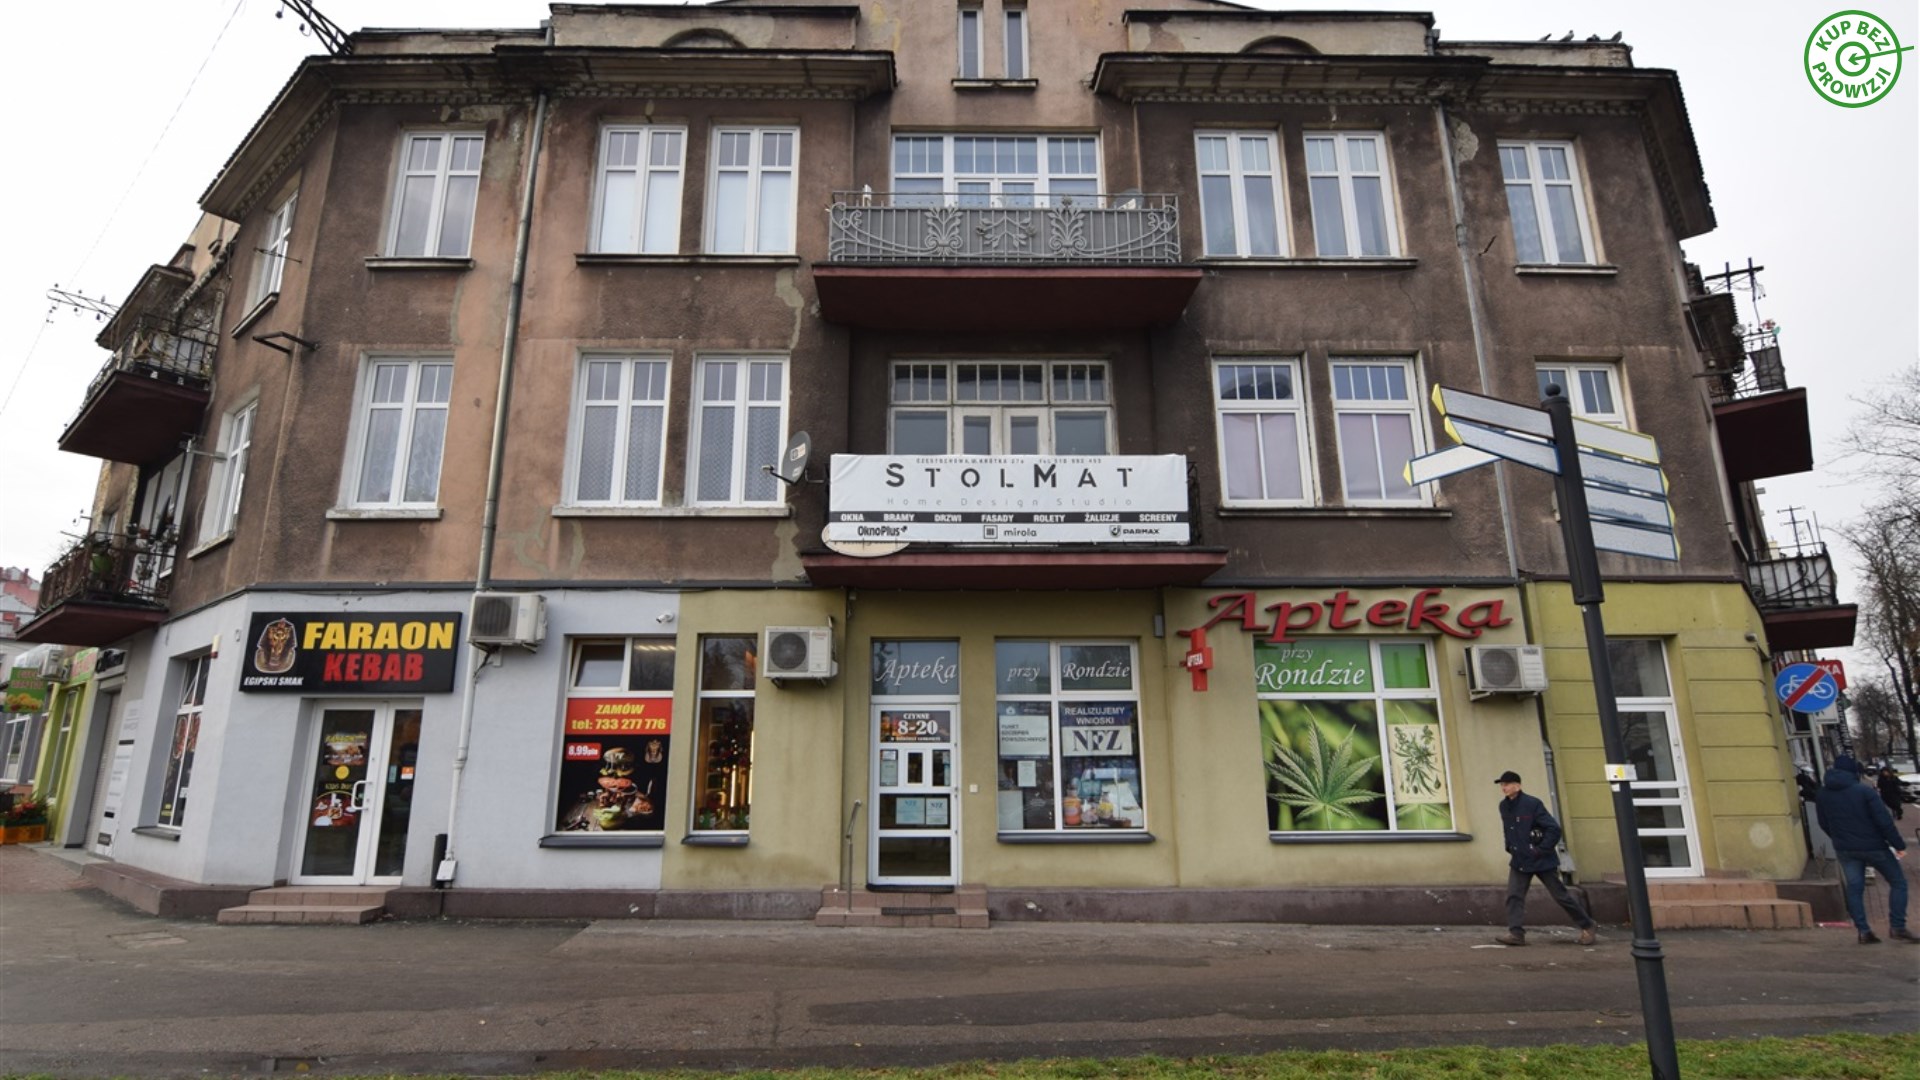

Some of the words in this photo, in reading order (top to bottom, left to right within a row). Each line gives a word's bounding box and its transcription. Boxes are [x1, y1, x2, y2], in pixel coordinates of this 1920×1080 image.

[886, 463, 1133, 488] STOLMAT
[887, 498, 942, 506] Home
[961, 498, 1038, 508] Design
[1057, 498, 1132, 507] Studio
[840, 513, 865, 522] OKNA
[883, 513, 915, 522] BRAMY
[934, 513, 962, 522] DRZWI
[981, 514, 1014, 522] FASADY
[1033, 514, 1065, 522] ROLETY
[1084, 512, 1120, 522] ŻALUZJE
[1139, 513, 1177, 522] SCREENY
[857, 525, 900, 537] OknoPlus
[1003, 527, 1037, 537] mirola
[1176, 588, 1513, 643] Apteka
[302, 621, 455, 650] FARAON
[1281, 646, 1314, 663] przy
[323, 652, 424, 682] KEBAB
[875, 656, 957, 686] Apteka
[1007, 666, 1041, 682] przy
[1063, 660, 1130, 681] Rondzie
[1255, 660, 1366, 690] Rondzie
[244, 676, 278, 686] EGIPSKI
[278, 676, 304, 686] SMAK
[595, 703, 645, 715] ZAMÓW
[1064, 706, 1125, 716] REALIZUJEMY
[572, 718, 593, 730] tel:
[595, 718, 619, 730] 733
[621, 718, 642, 730] 277
[644, 718, 667, 730] 776
[897, 719, 938, 735] 8-20
[1076, 717, 1115, 725] WNIOSKI
[1072, 729, 1123, 752] NFZ
